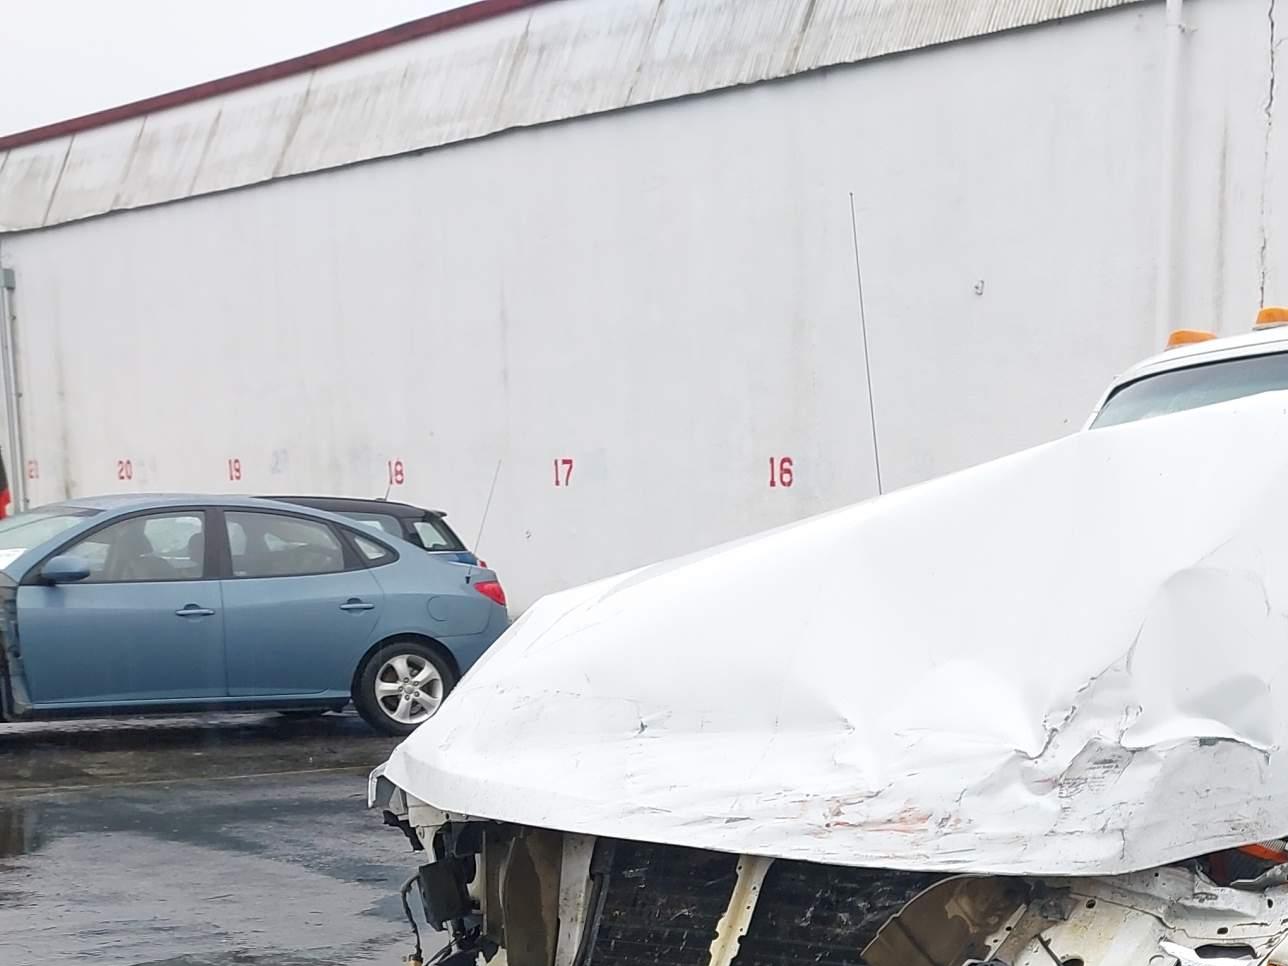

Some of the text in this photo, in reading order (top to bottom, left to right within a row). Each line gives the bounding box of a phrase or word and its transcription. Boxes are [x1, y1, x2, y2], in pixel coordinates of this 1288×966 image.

[117, 460, 133, 480] 20
[228, 459, 242, 481] 19
[388, 460, 404, 485] 18
[554, 458, 573, 487] 17
[769, 456, 793, 488] 16
